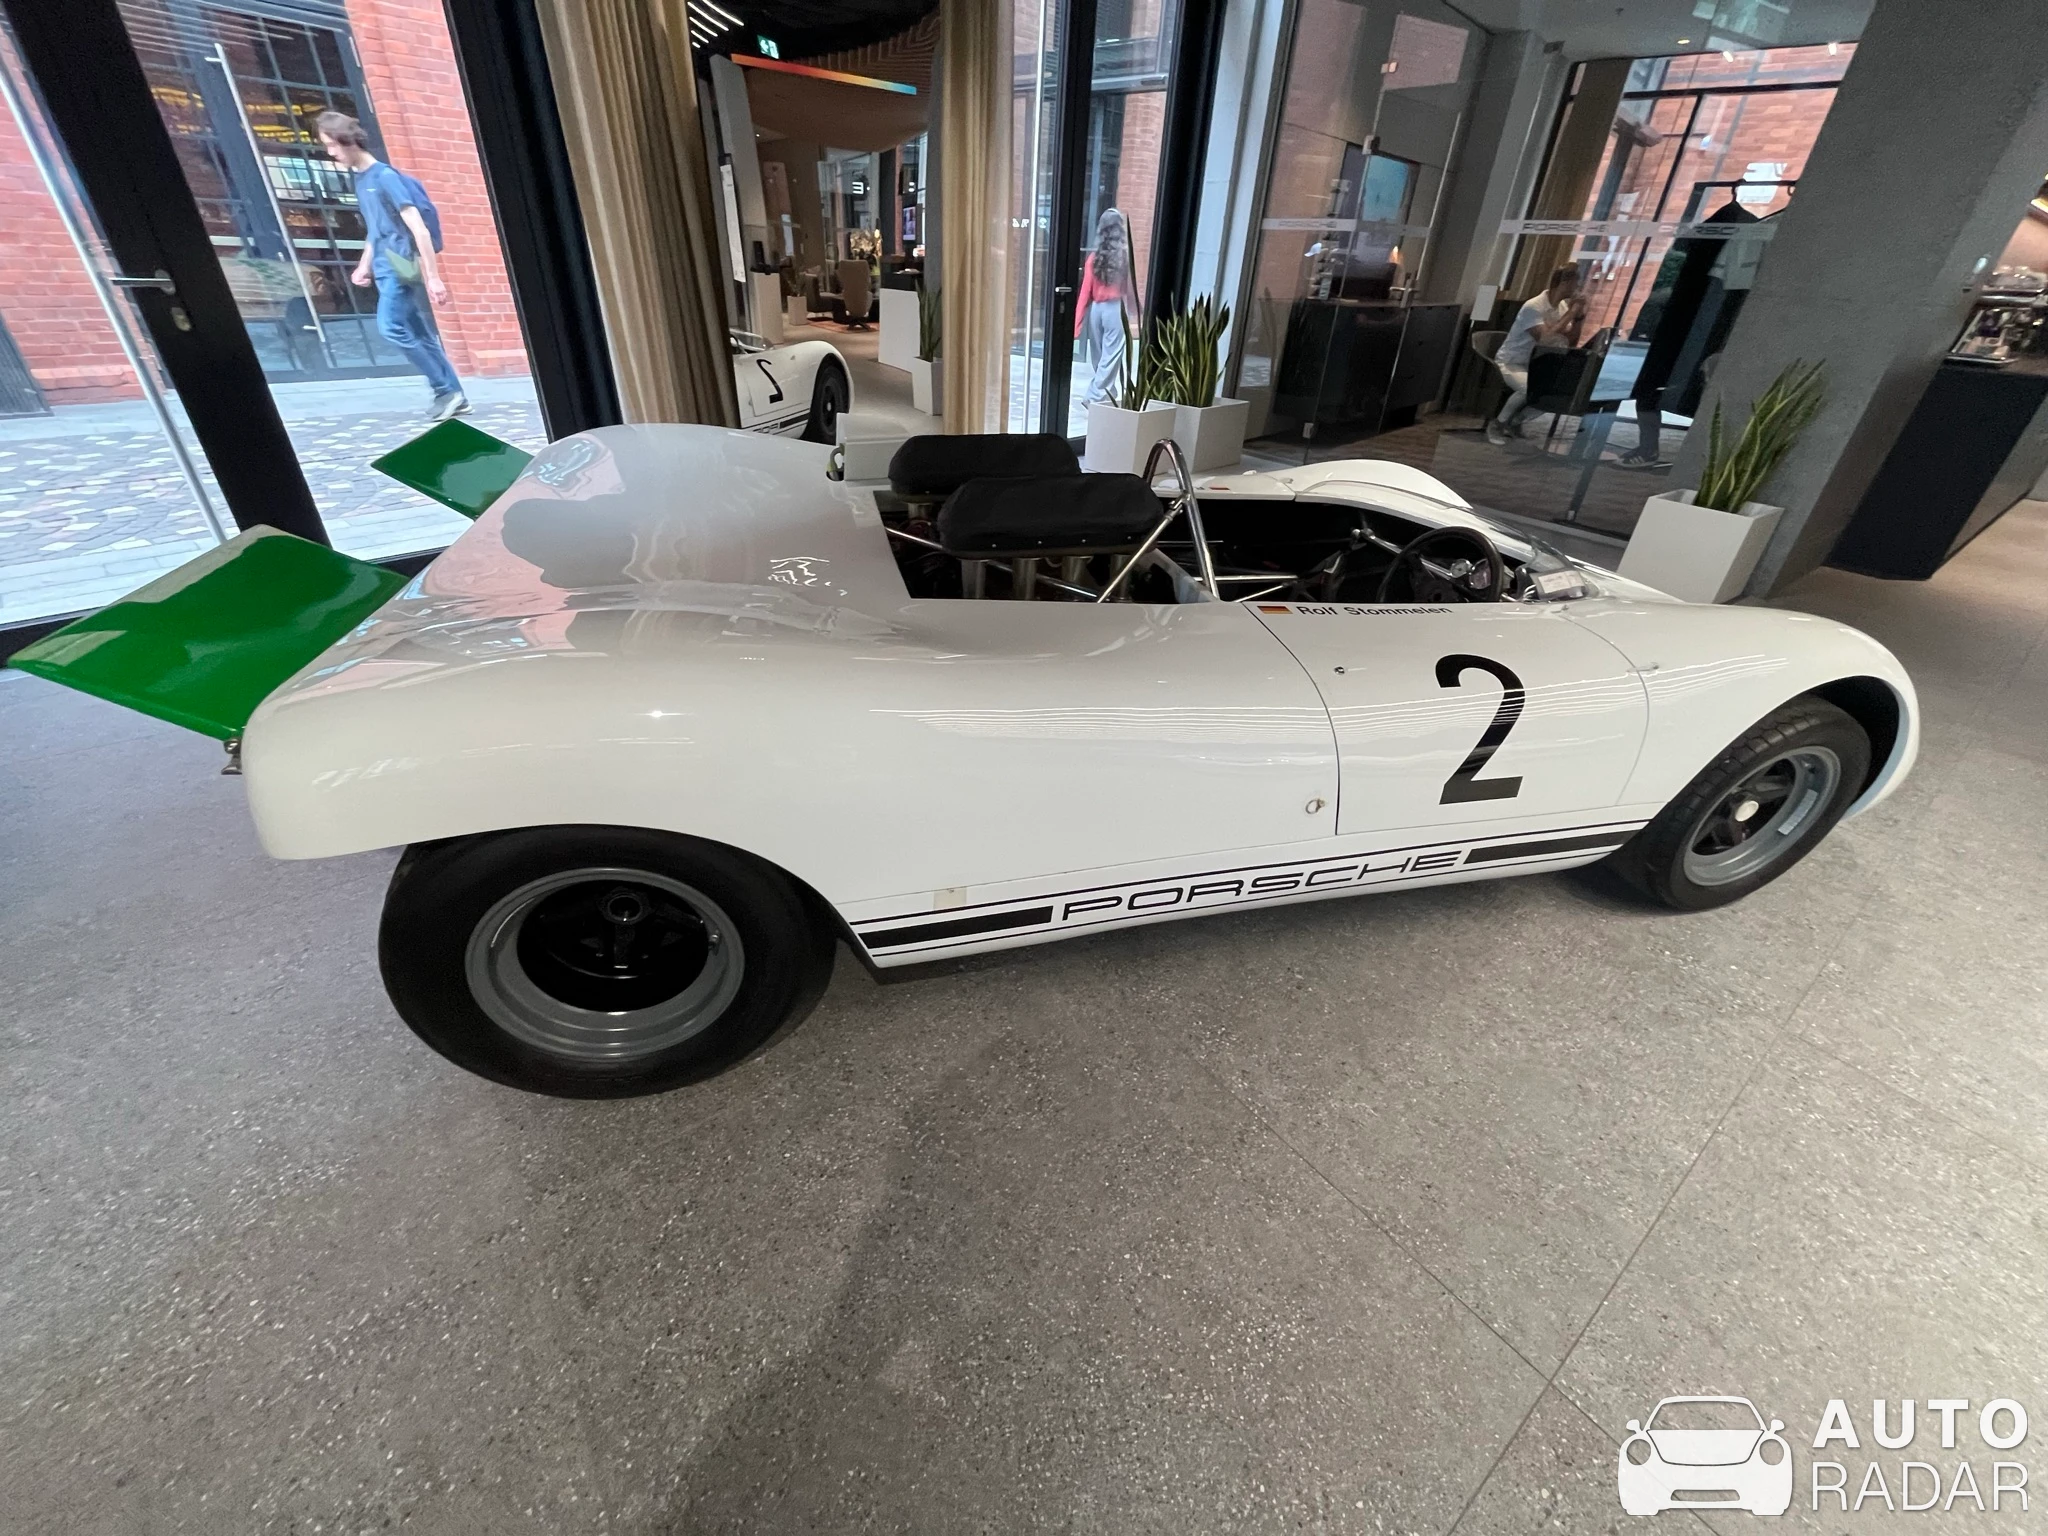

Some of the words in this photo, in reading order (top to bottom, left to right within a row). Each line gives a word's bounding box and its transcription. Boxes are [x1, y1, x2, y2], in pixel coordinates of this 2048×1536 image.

[1522, 222, 1609, 233] PORSCHE
[1295, 605, 1339, 615] Rolf
[1343, 606, 1455, 616] Stommelen
[1434, 653, 1526, 805] 2
[1061, 849, 1463, 922] PORSCHE
